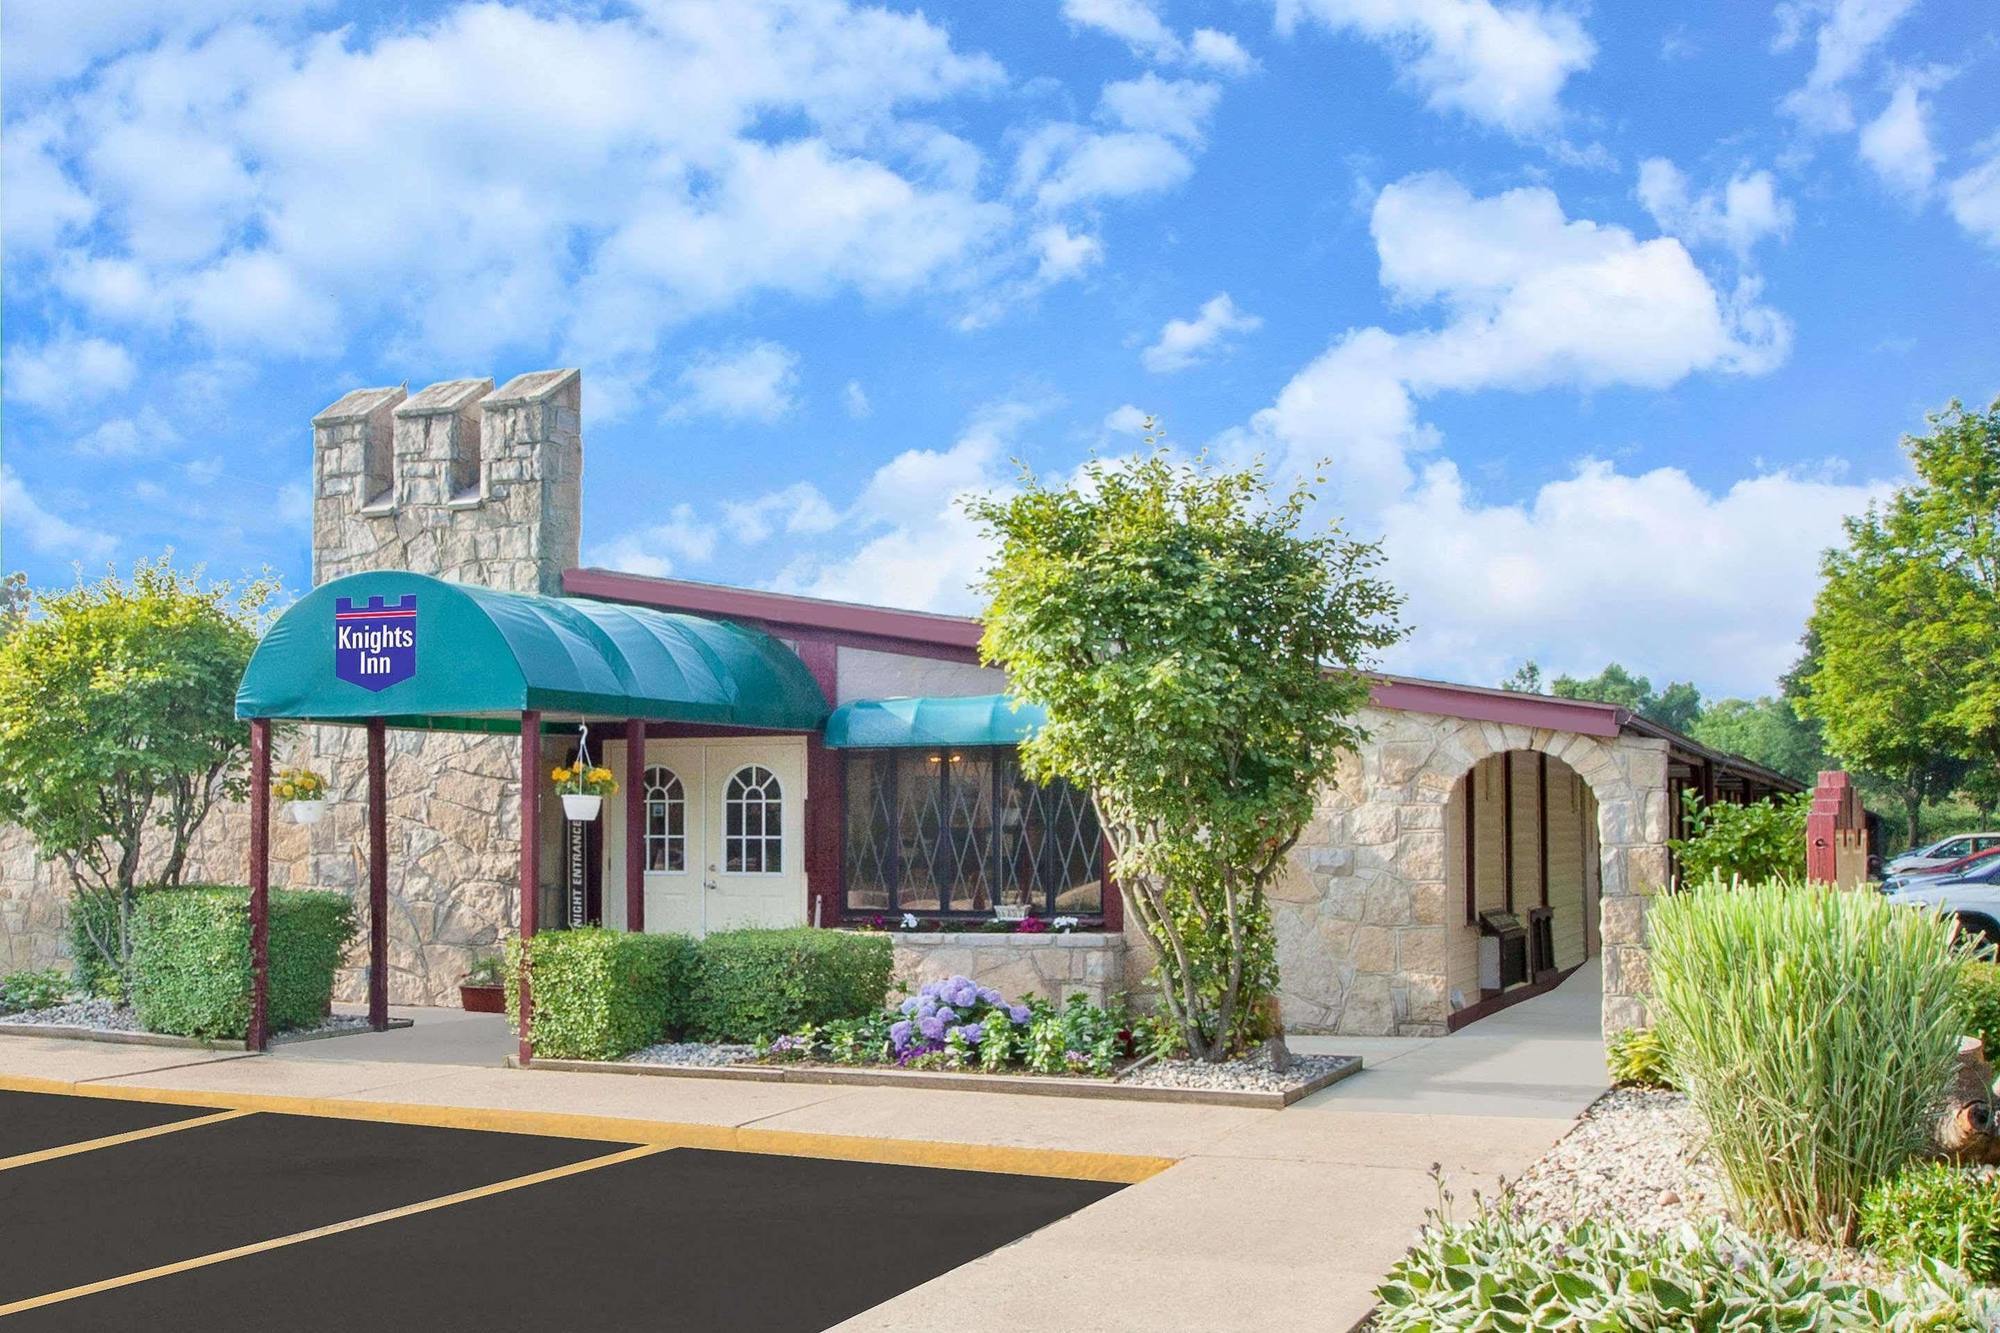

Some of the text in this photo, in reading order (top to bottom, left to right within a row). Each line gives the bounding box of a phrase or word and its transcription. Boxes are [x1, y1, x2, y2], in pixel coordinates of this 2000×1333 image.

[338, 624, 413, 654] Knights
[360, 651, 391, 675] Inn
[572, 820, 582, 928] NIGHT ENTRANCE
